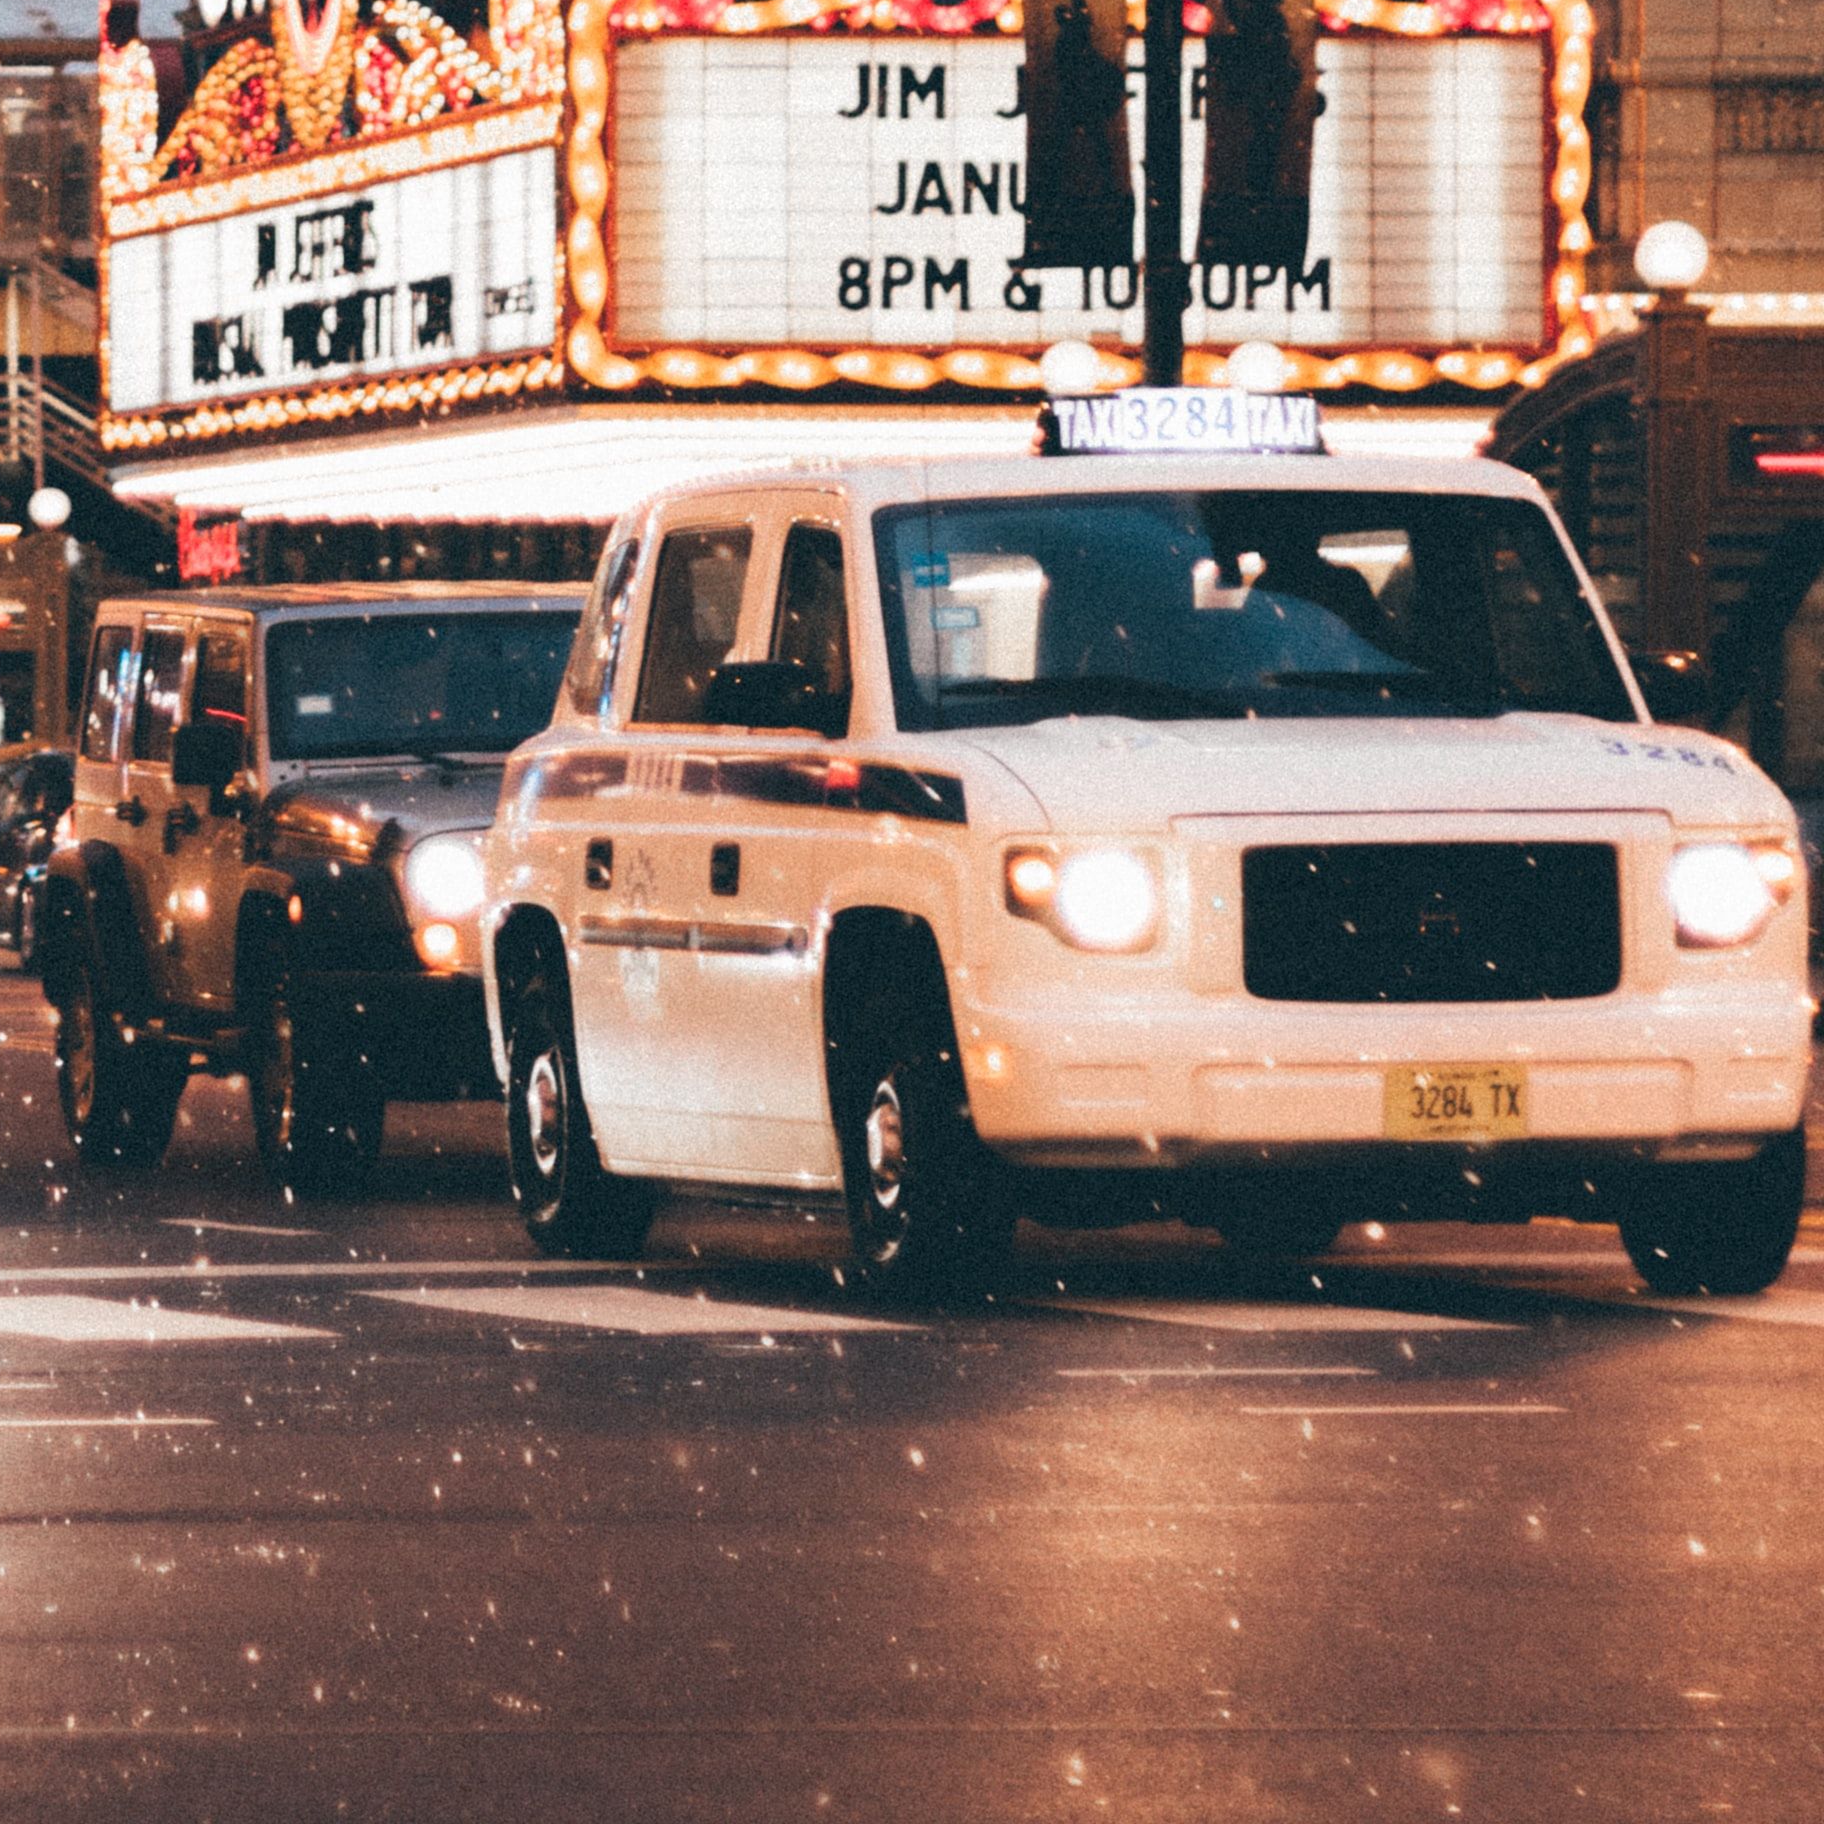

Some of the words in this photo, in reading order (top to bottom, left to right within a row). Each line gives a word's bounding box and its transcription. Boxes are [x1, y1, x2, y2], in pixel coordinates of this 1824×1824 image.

[837, 62, 946, 120] JIM
[876, 161, 1028, 216] JANU
[838, 256, 969, 312] 8PM
[1081, 257, 1331, 313] 100PM
[1052, 398, 1121, 450] TAXI
[1128, 395, 1237, 441] 3284
[1245, 396, 1317, 447] TAXI
[1600, 737, 1736, 776] 3284
[1410, 1084, 1473, 1119] 3284
[1490, 1082, 1521, 1117] TX
